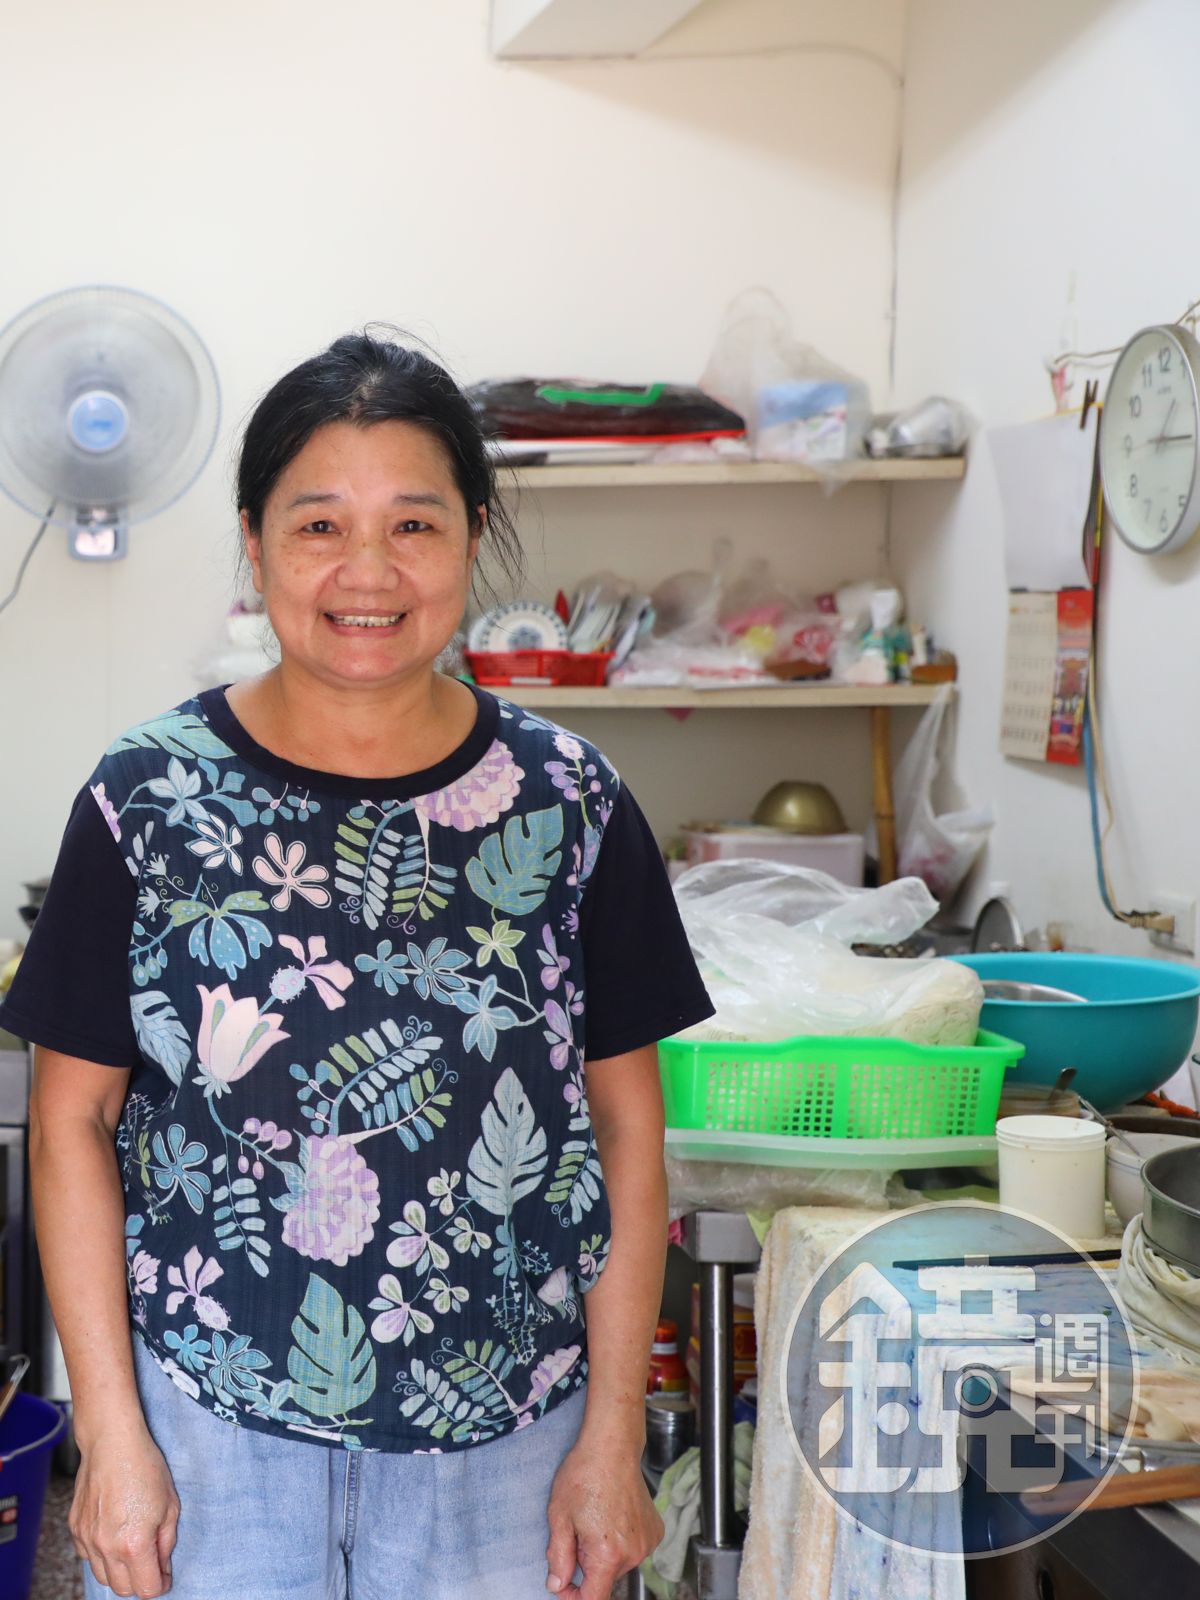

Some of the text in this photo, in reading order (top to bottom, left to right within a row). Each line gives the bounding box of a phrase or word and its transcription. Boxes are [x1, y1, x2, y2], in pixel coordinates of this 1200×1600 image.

[1158, 347, 1172, 373] 12
[1142, 363, 1154, 389] 11
[1129, 395, 1143, 419] 10
[1123, 434, 1133, 458] 9
[1129, 474, 1138, 498] 8
[1142, 499, 1153, 522] 7
[1159, 510, 1169, 533] 6
